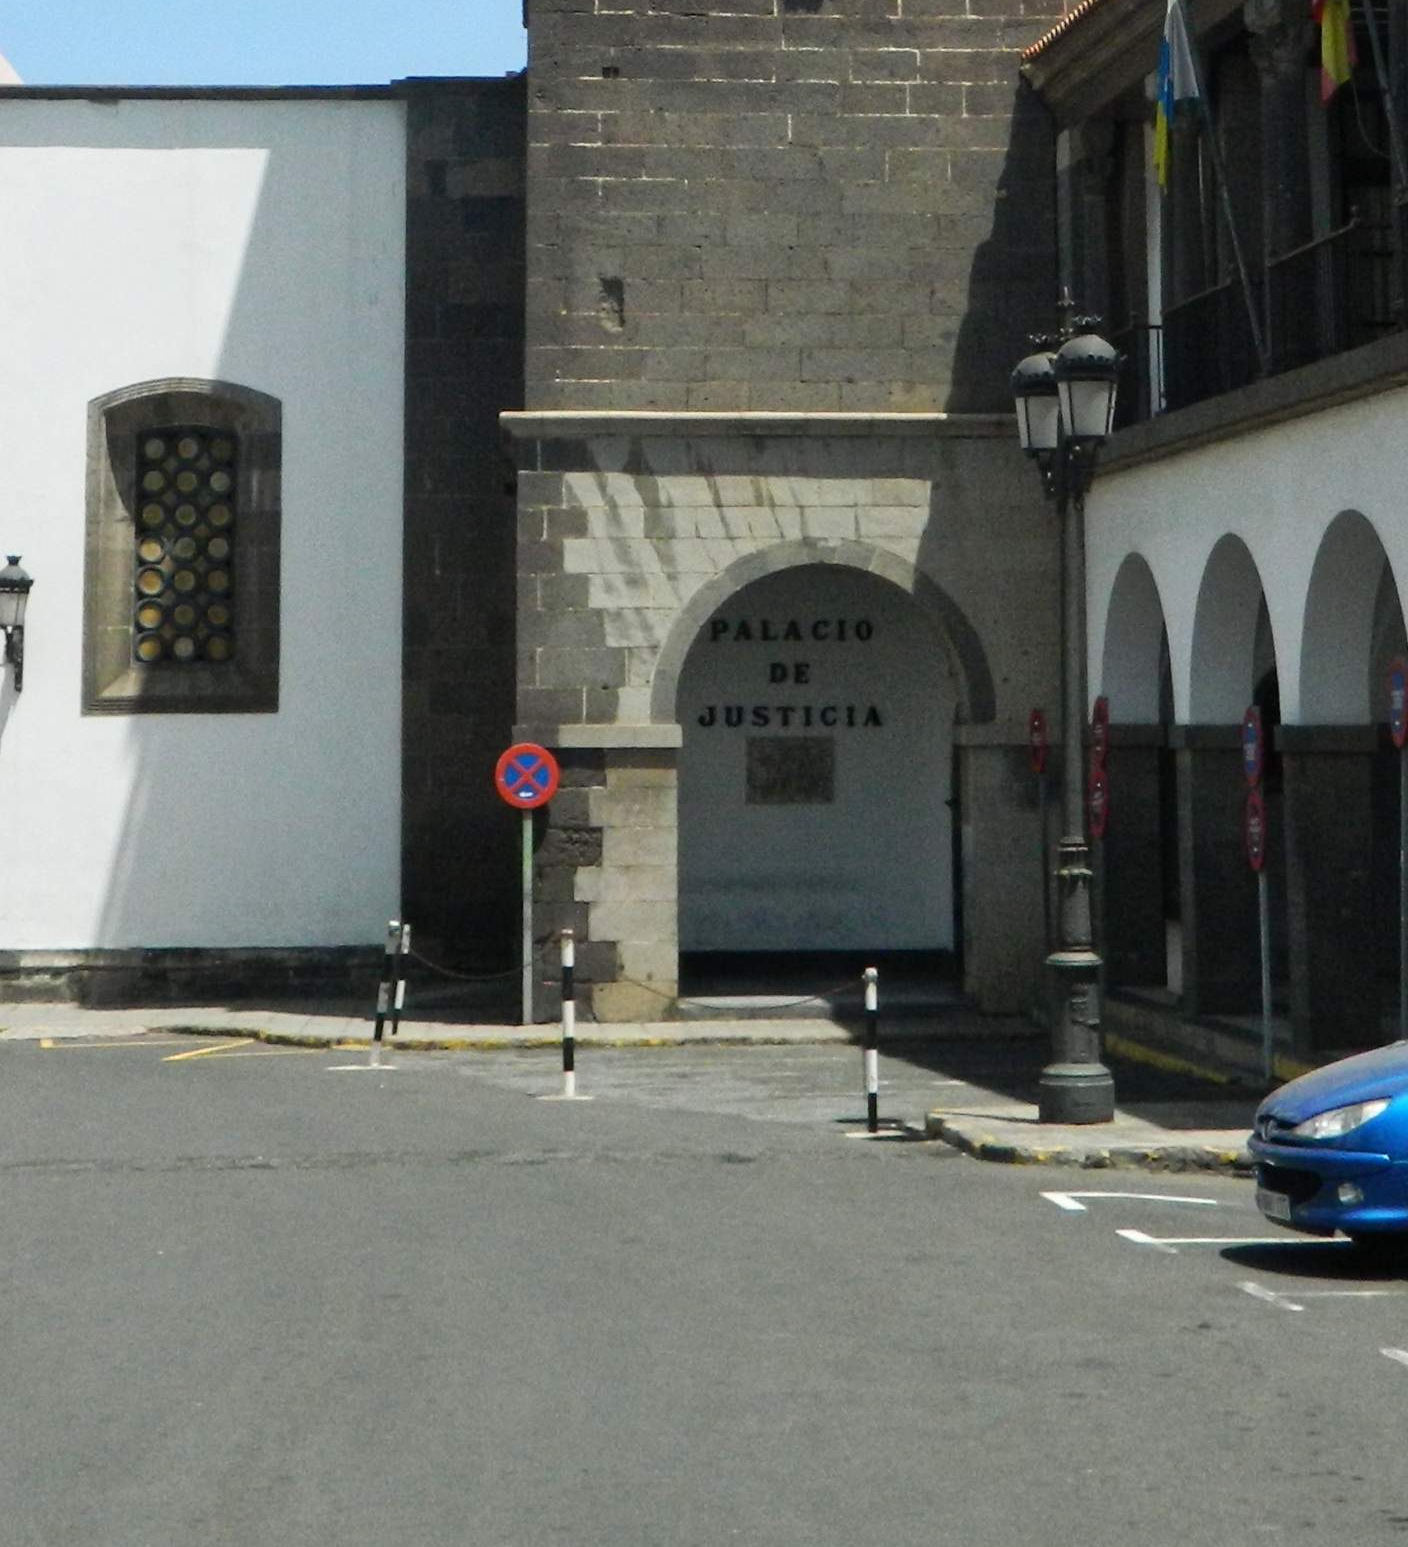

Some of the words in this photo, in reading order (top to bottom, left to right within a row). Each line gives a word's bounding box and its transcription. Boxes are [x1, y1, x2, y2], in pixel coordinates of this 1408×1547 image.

[710, 619, 874, 642] PALACIO
[769, 662, 811, 684] DE
[697, 705, 884, 728] JUSTICIA
